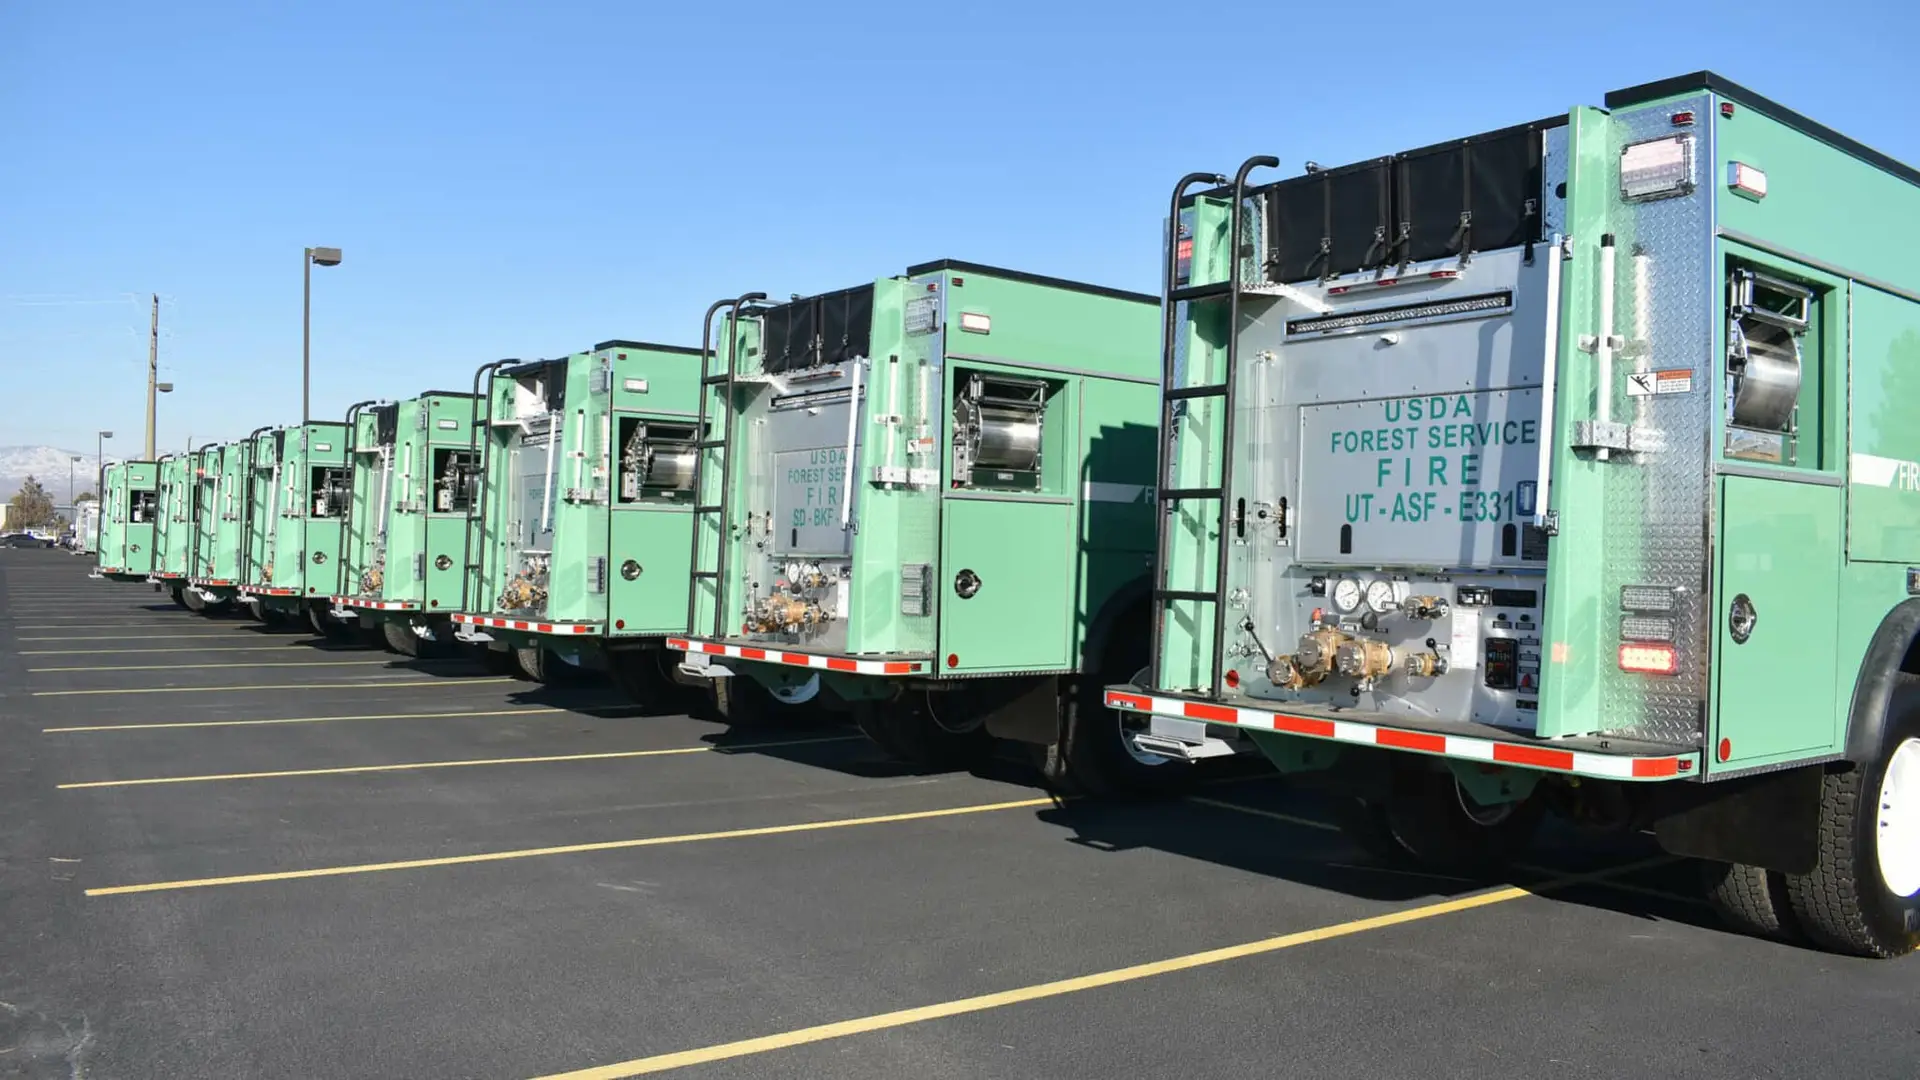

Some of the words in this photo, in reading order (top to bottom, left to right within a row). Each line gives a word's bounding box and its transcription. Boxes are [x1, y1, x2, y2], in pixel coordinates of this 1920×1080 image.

[1385, 395, 1472, 422] USDA
[1331, 427, 1419, 453] FOREST
[1428, 420, 1536, 448] SERVICE
[810, 450, 847, 465] USDA
[787, 468, 825, 484] FOREST
[1377, 454, 1479, 487] FIRE
[806, 486, 845, 506] FIR
